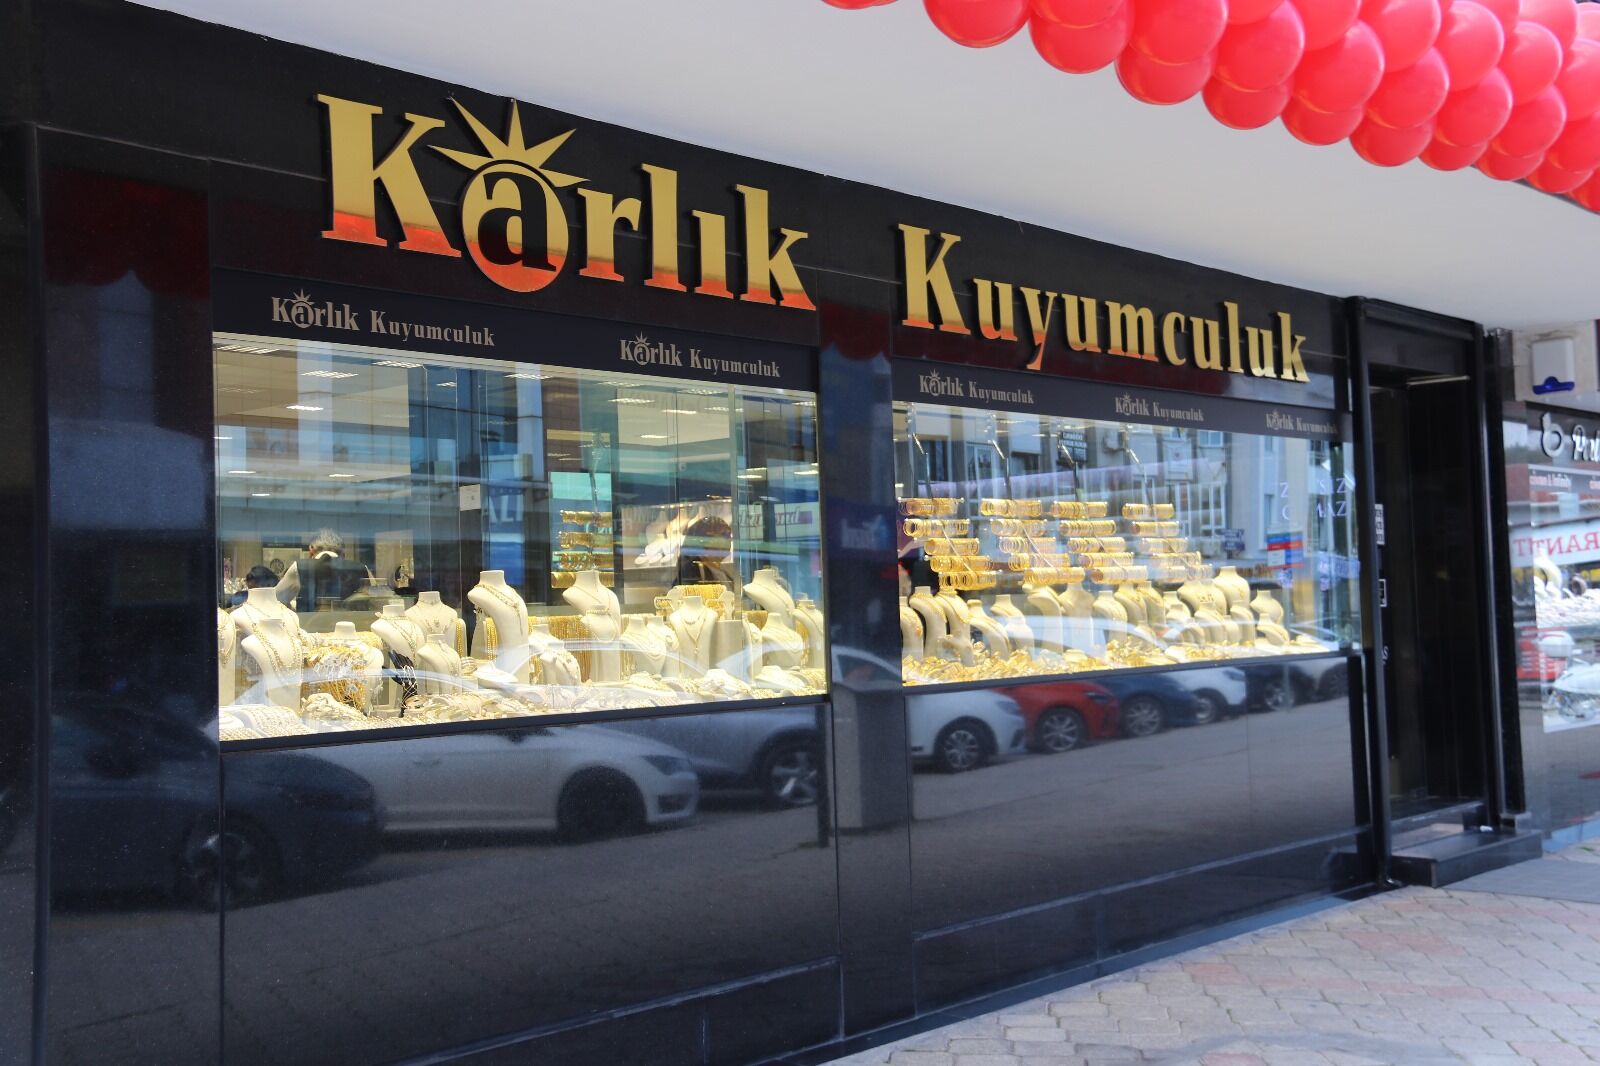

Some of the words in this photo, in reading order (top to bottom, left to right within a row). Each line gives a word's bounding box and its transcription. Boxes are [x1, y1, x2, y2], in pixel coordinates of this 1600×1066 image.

[315, 93, 817, 311] Karlık
[897, 223, 1311, 383] Kuyumculuk
[271, 288, 360, 331] Karlık
[369, 309, 496, 347] Kuyumculuk
[620, 331, 683, 367] Karlık
[689, 348, 781, 378] Kuyumculuk
[919, 368, 965, 397] Karlık
[968, 380, 1035, 404] Kuyumculuk
[1153, 401, 1205, 422] Kuyumculuk
